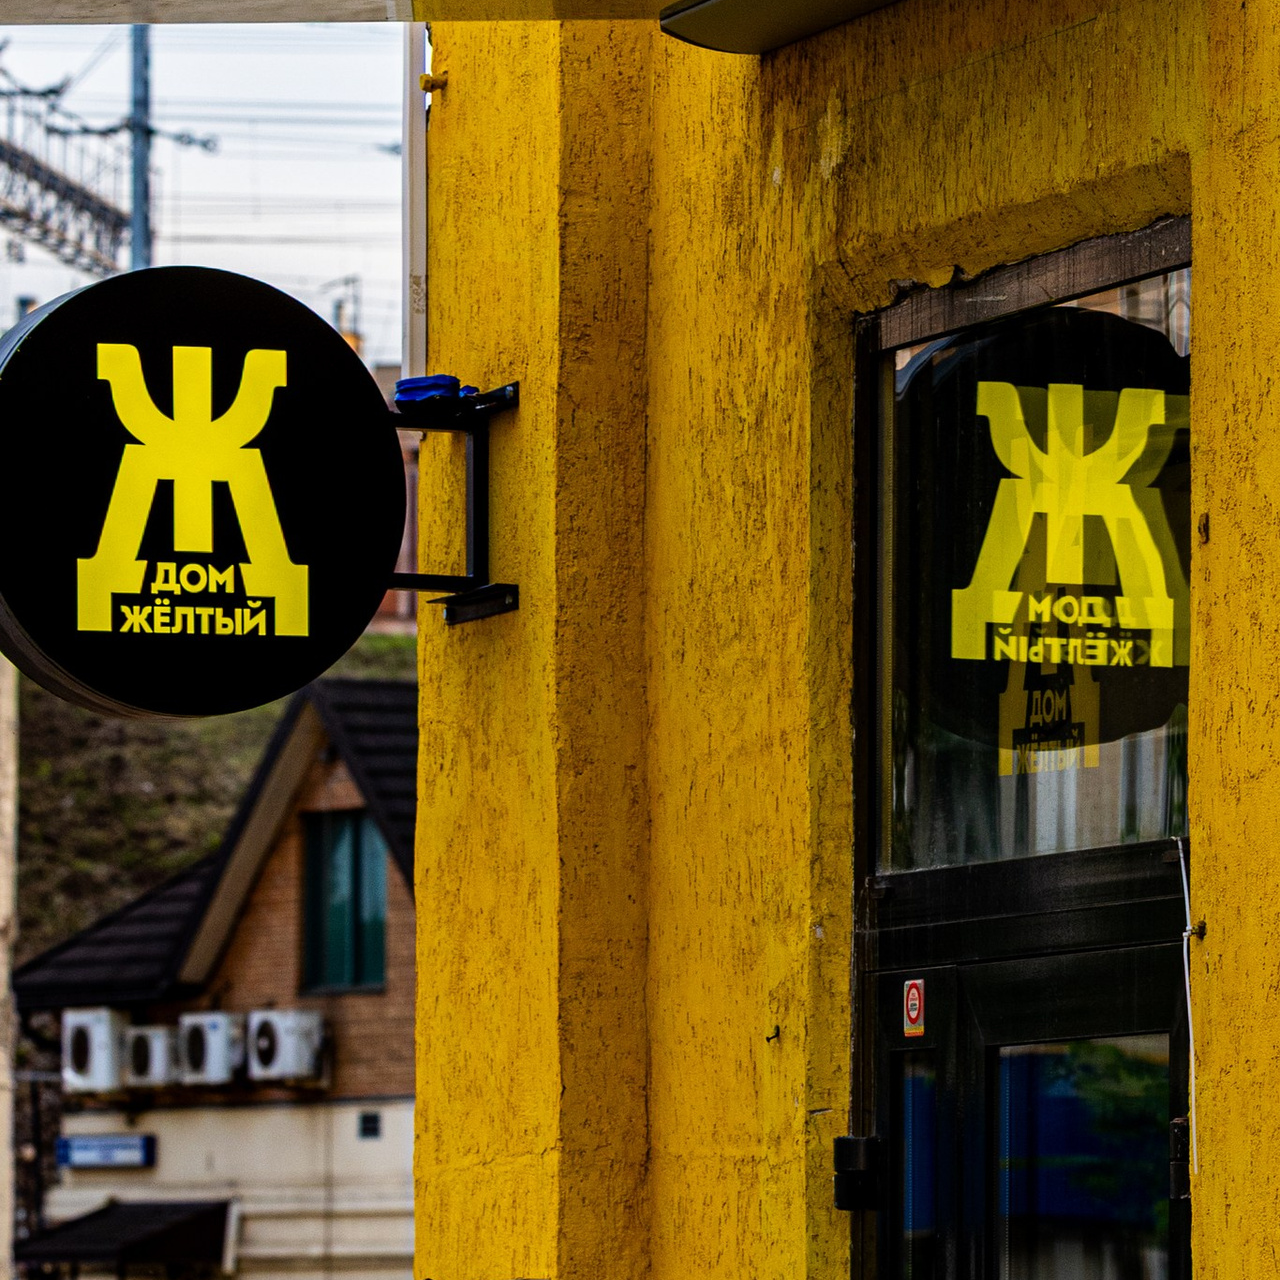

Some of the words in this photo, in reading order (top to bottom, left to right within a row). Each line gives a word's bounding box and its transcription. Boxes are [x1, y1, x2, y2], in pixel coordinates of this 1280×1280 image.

[151, 562, 235, 595] ДОМ
[120, 598, 267, 636] ЖЁЛТЫЙ
[1029, 688, 1068, 726] ДОМ
